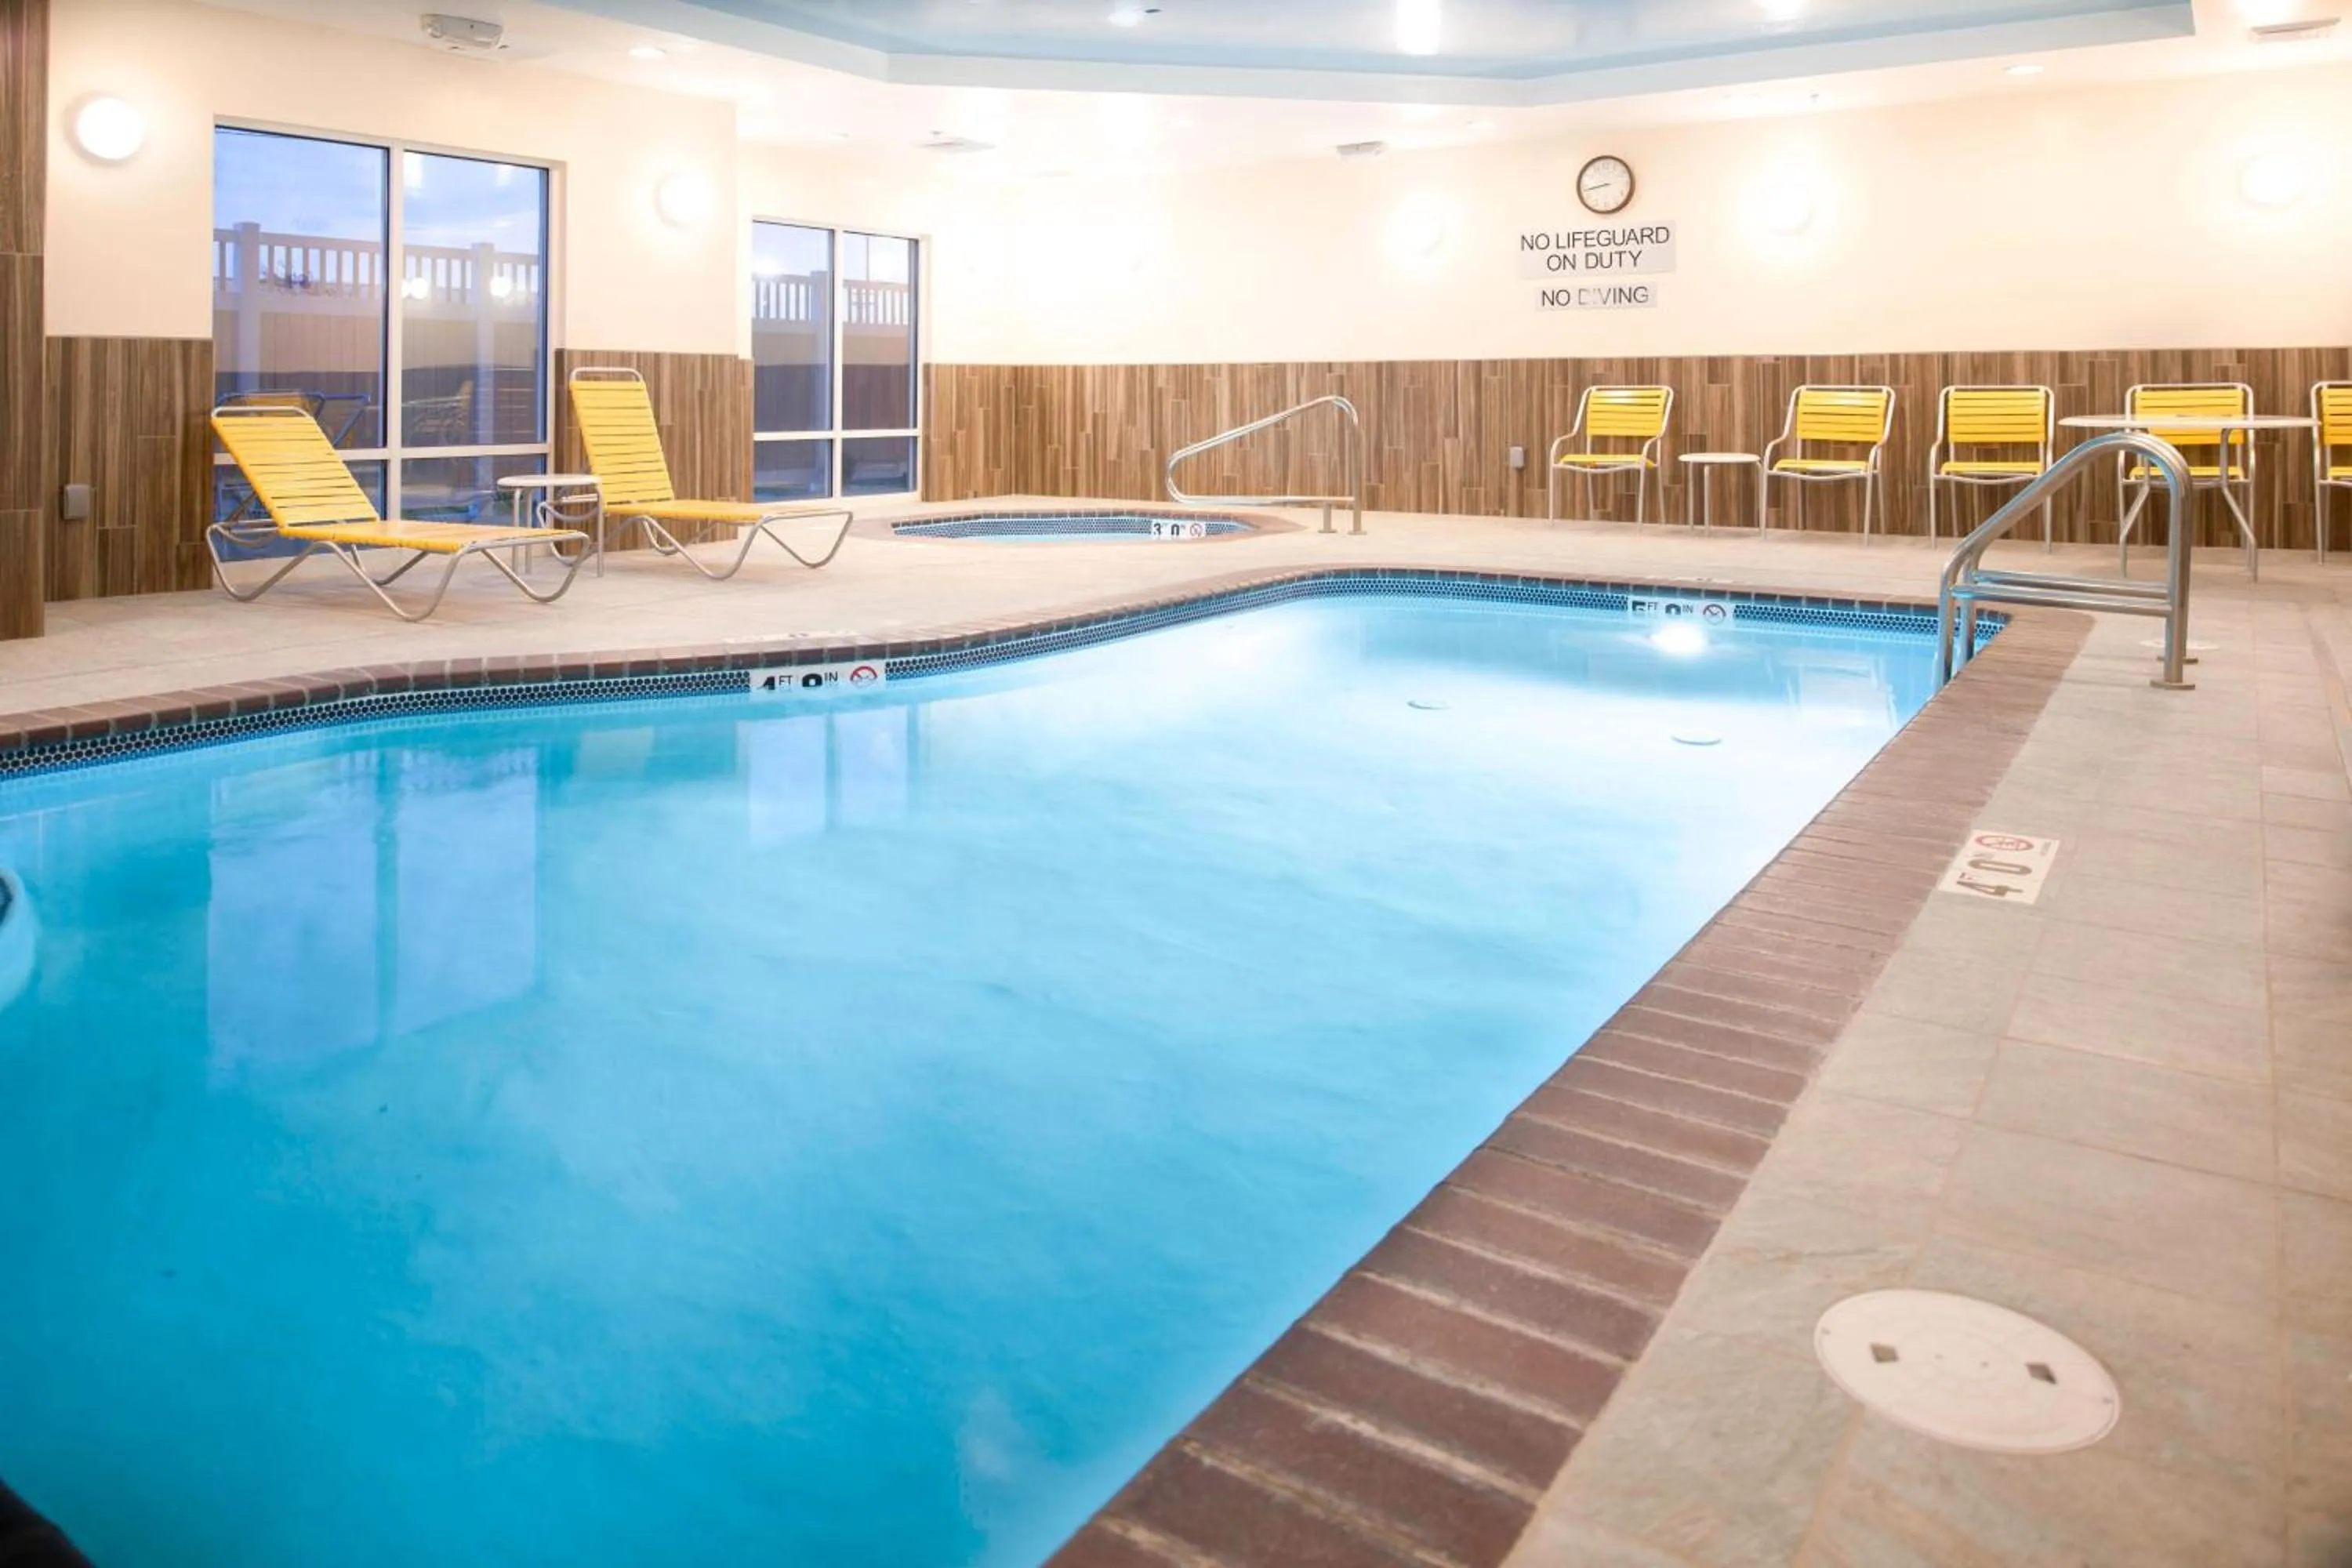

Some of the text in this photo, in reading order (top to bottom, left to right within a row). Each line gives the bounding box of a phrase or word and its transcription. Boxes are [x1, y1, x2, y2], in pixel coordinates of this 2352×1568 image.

[1521, 227, 1670, 251] NO LIFEGUARD
[1547, 250, 1642, 271] ON DUTY
[1541, 289, 1570, 307] NO
[824, 671, 838, 681] IN
